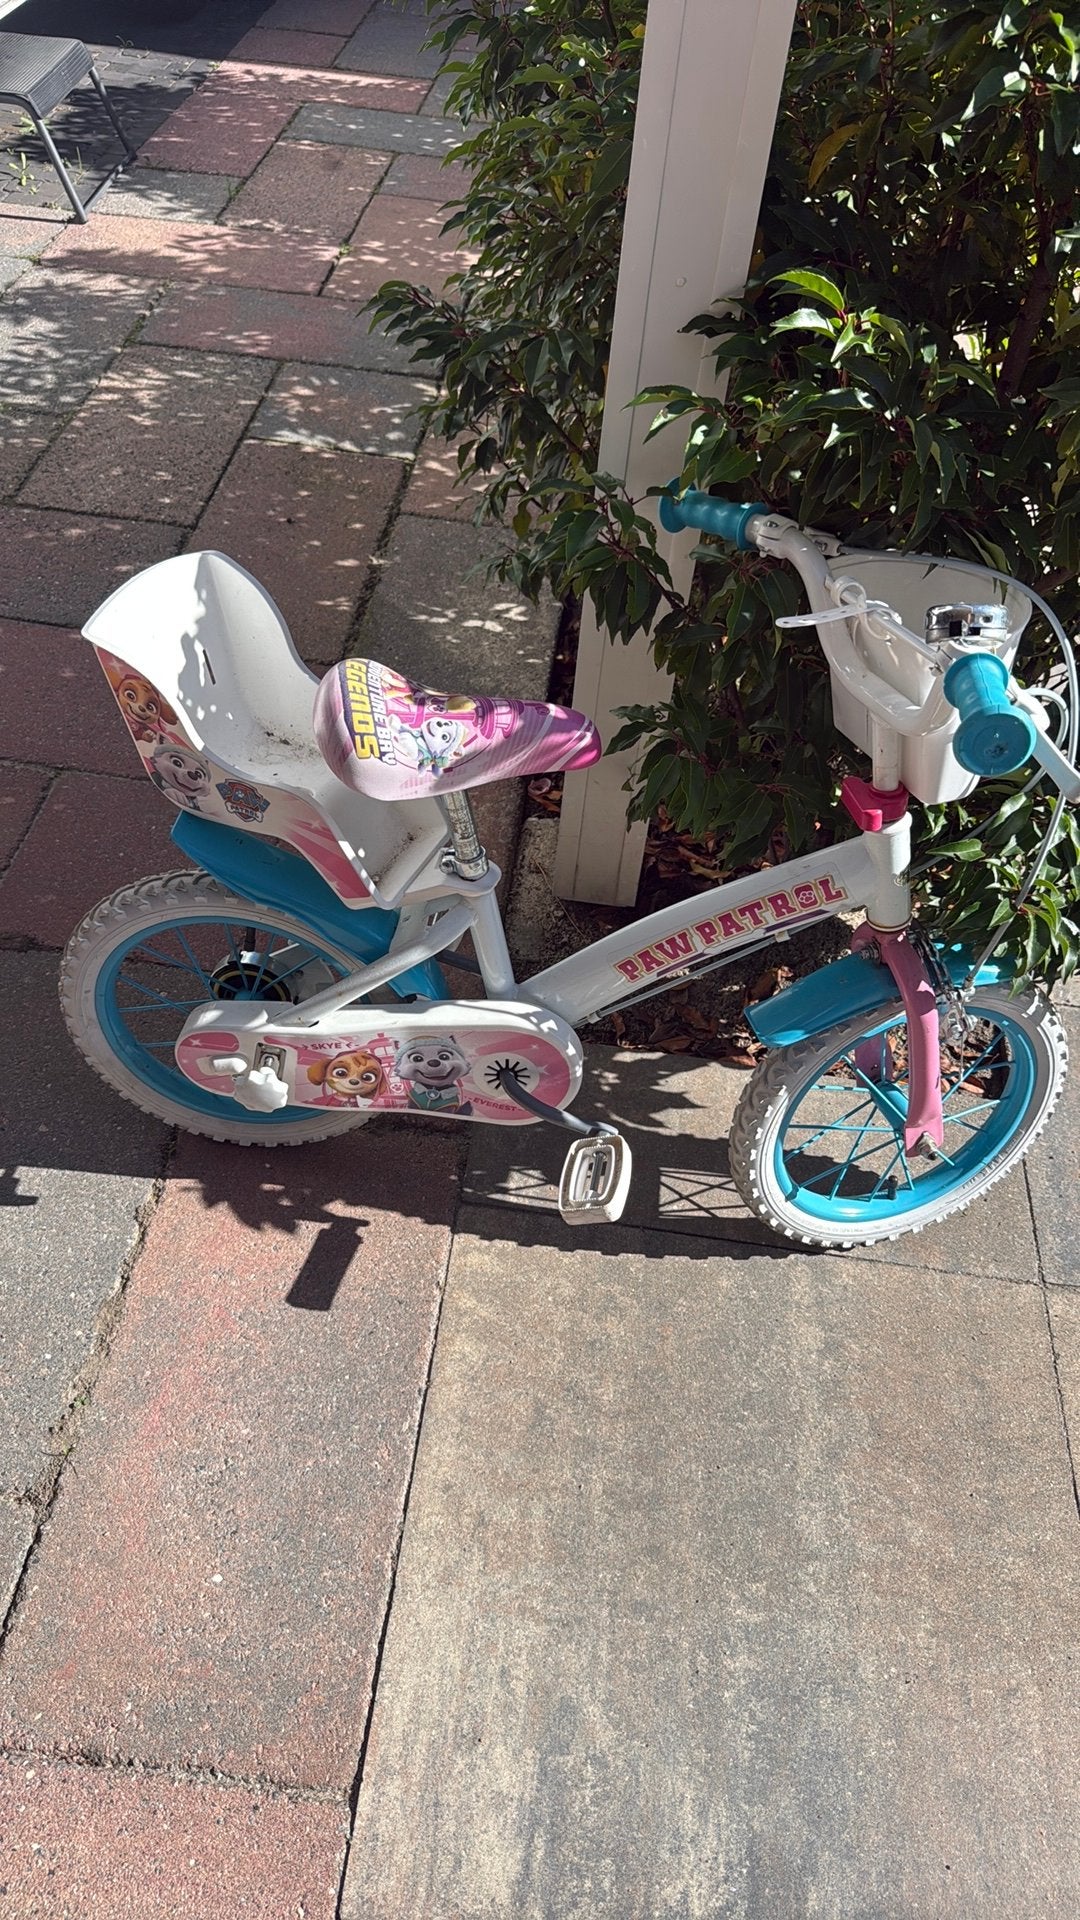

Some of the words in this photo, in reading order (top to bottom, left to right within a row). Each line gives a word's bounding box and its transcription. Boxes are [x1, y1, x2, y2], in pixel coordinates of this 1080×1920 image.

[345, 659, 380, 760] EGENDS
[376, 726, 398, 766] BAY
[612, 931, 695, 983] PAW
[695, 874, 849, 946] PATROL
[311, 1042, 342, 1051] SKYE
[473, 1097, 518, 1112] EVEREST
